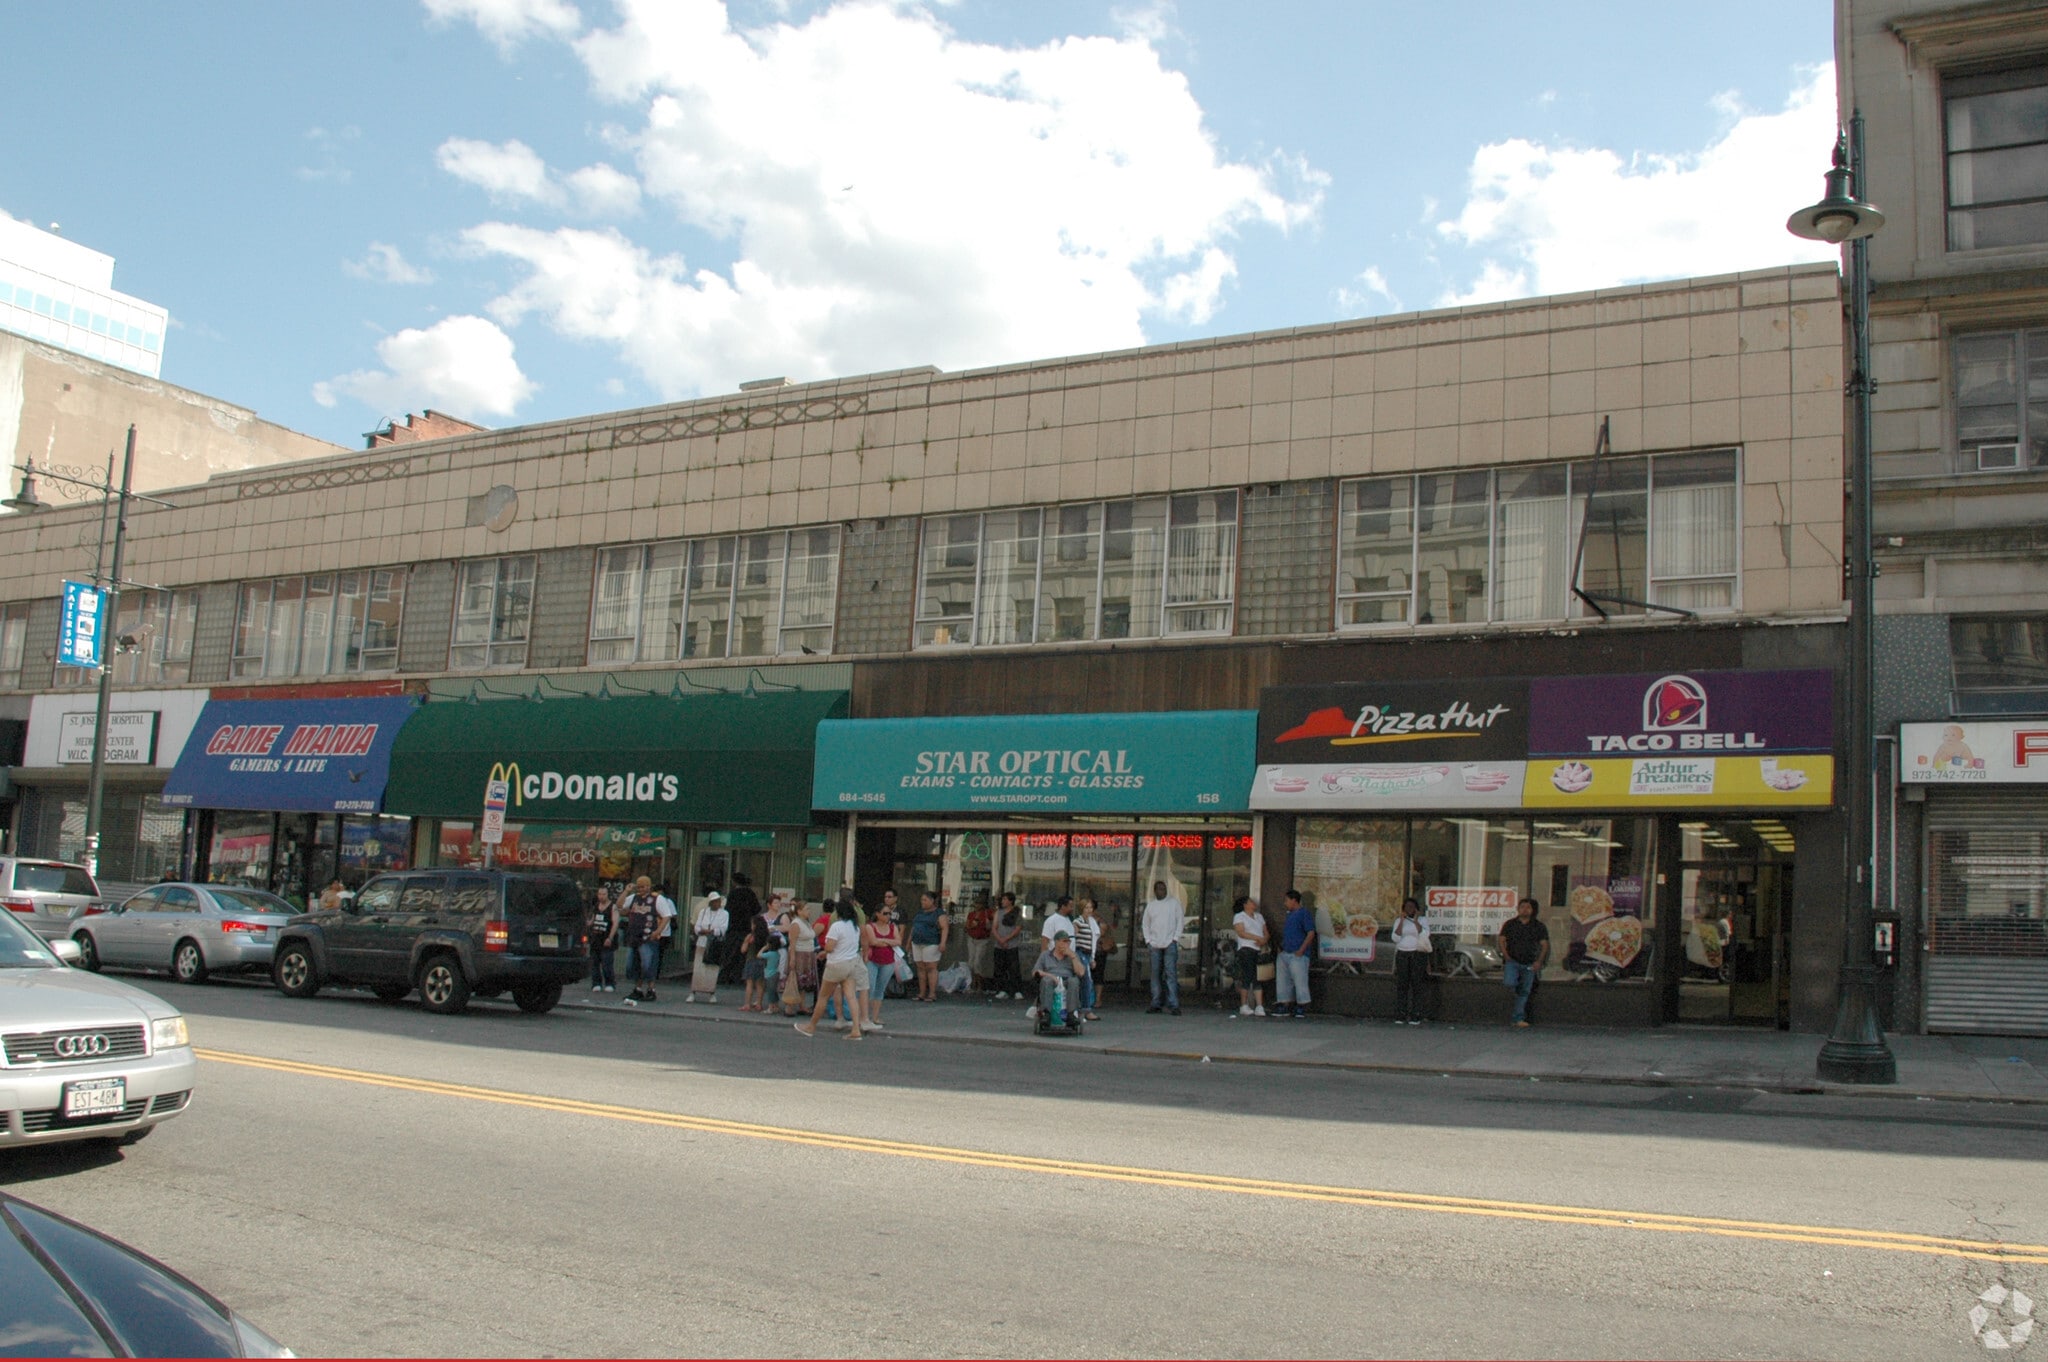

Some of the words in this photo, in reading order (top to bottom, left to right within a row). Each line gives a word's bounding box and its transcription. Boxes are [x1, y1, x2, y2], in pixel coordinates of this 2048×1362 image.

[64, 586, 76, 655] PATERSON
[111, 715, 144, 725] HOSPITAL
[1351, 705, 1436, 737] Pizza
[1440, 701, 1510, 730] Hut
[206, 725, 284, 755] GAME
[283, 724, 378, 756] MANIA
[1588, 734, 1673, 751] TACO
[1680, 733, 1762, 749] BELL
[104, 749, 138, 760] OGRAM
[229, 758, 282, 772] GAMERS
[284, 759, 294, 772] 4
[295, 759, 328, 773] LIFE
[916, 751, 990, 774] STAR
[999, 750, 1133, 774] OPTICAL
[1639, 760, 1698, 774] Arthur
[900, 775, 955, 788] EXAMS
[970, 775, 1053, 788] CONTACTS
[1068, 775, 1144, 788] GLASSES
[1632, 770, 1713, 784] Treacher's
[1911, 770, 1986, 780] 973-742-7720
[839, 792, 886, 802] 684-1545
[1196, 793, 1220, 804] 158
[1071, 833, 1135, 848] CONTACTS
[1142, 835, 1204, 849] GLASSES
[1430, 892, 1509, 906] SPECIAL
